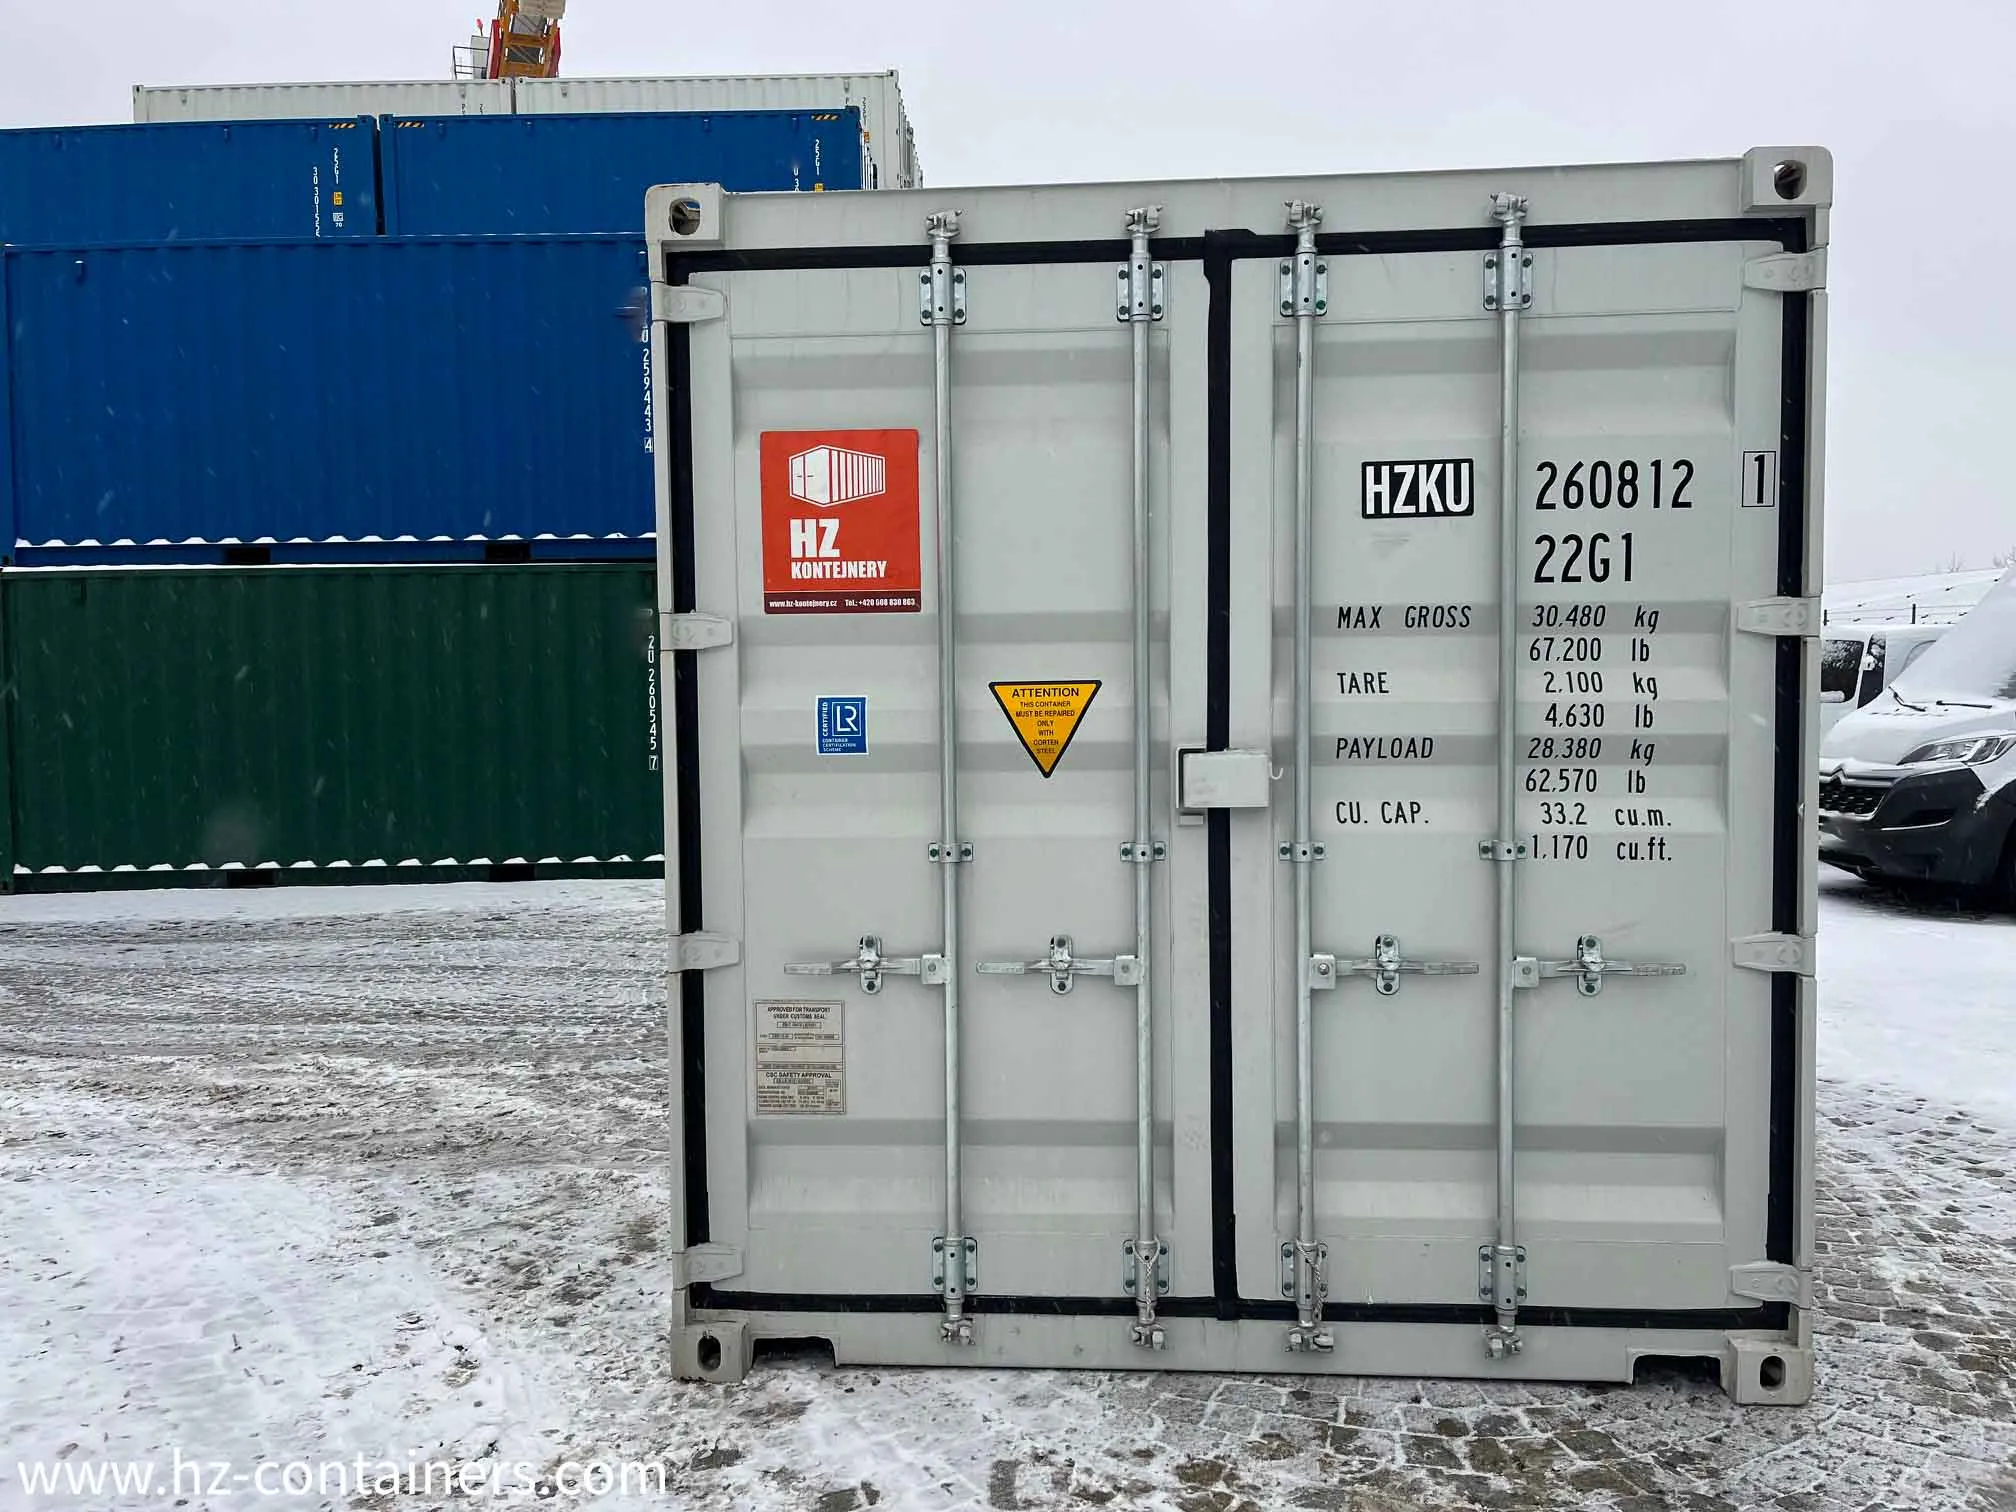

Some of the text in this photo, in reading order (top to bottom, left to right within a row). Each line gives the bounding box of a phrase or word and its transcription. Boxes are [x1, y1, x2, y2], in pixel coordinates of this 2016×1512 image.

[643, 349, 652, 432] 259443
[645, 438, 653, 453] 4
[1365, 454, 1766, 516] HZKU 260812 1
[790, 519, 841, 558] HZ
[791, 561, 887, 579] KONTEJNERY
[1533, 532, 1634, 584] 22G1
[1337, 606, 1473, 630] MAX GROSS
[1634, 605, 1659, 634] kg
[1632, 638, 1649, 662] lb
[1012, 688, 1079, 698] ATTENTION
[1337, 672, 1389, 695] TARE
[1633, 672, 1658, 700] kg
[648, 669, 657, 750] 260545
[837, 706, 858, 731] LR
[1635, 704, 1653, 728] lb
[650, 755, 657, 770] 7
[1336, 737, 1434, 760] PAYLOAD
[1630, 739, 1655, 766] kg
[1628, 770, 1646, 793] lb
[1336, 801, 1672, 826] CU. CAP. 33.2 cu.m.
[1617, 836, 1672, 861] cu.ft.
